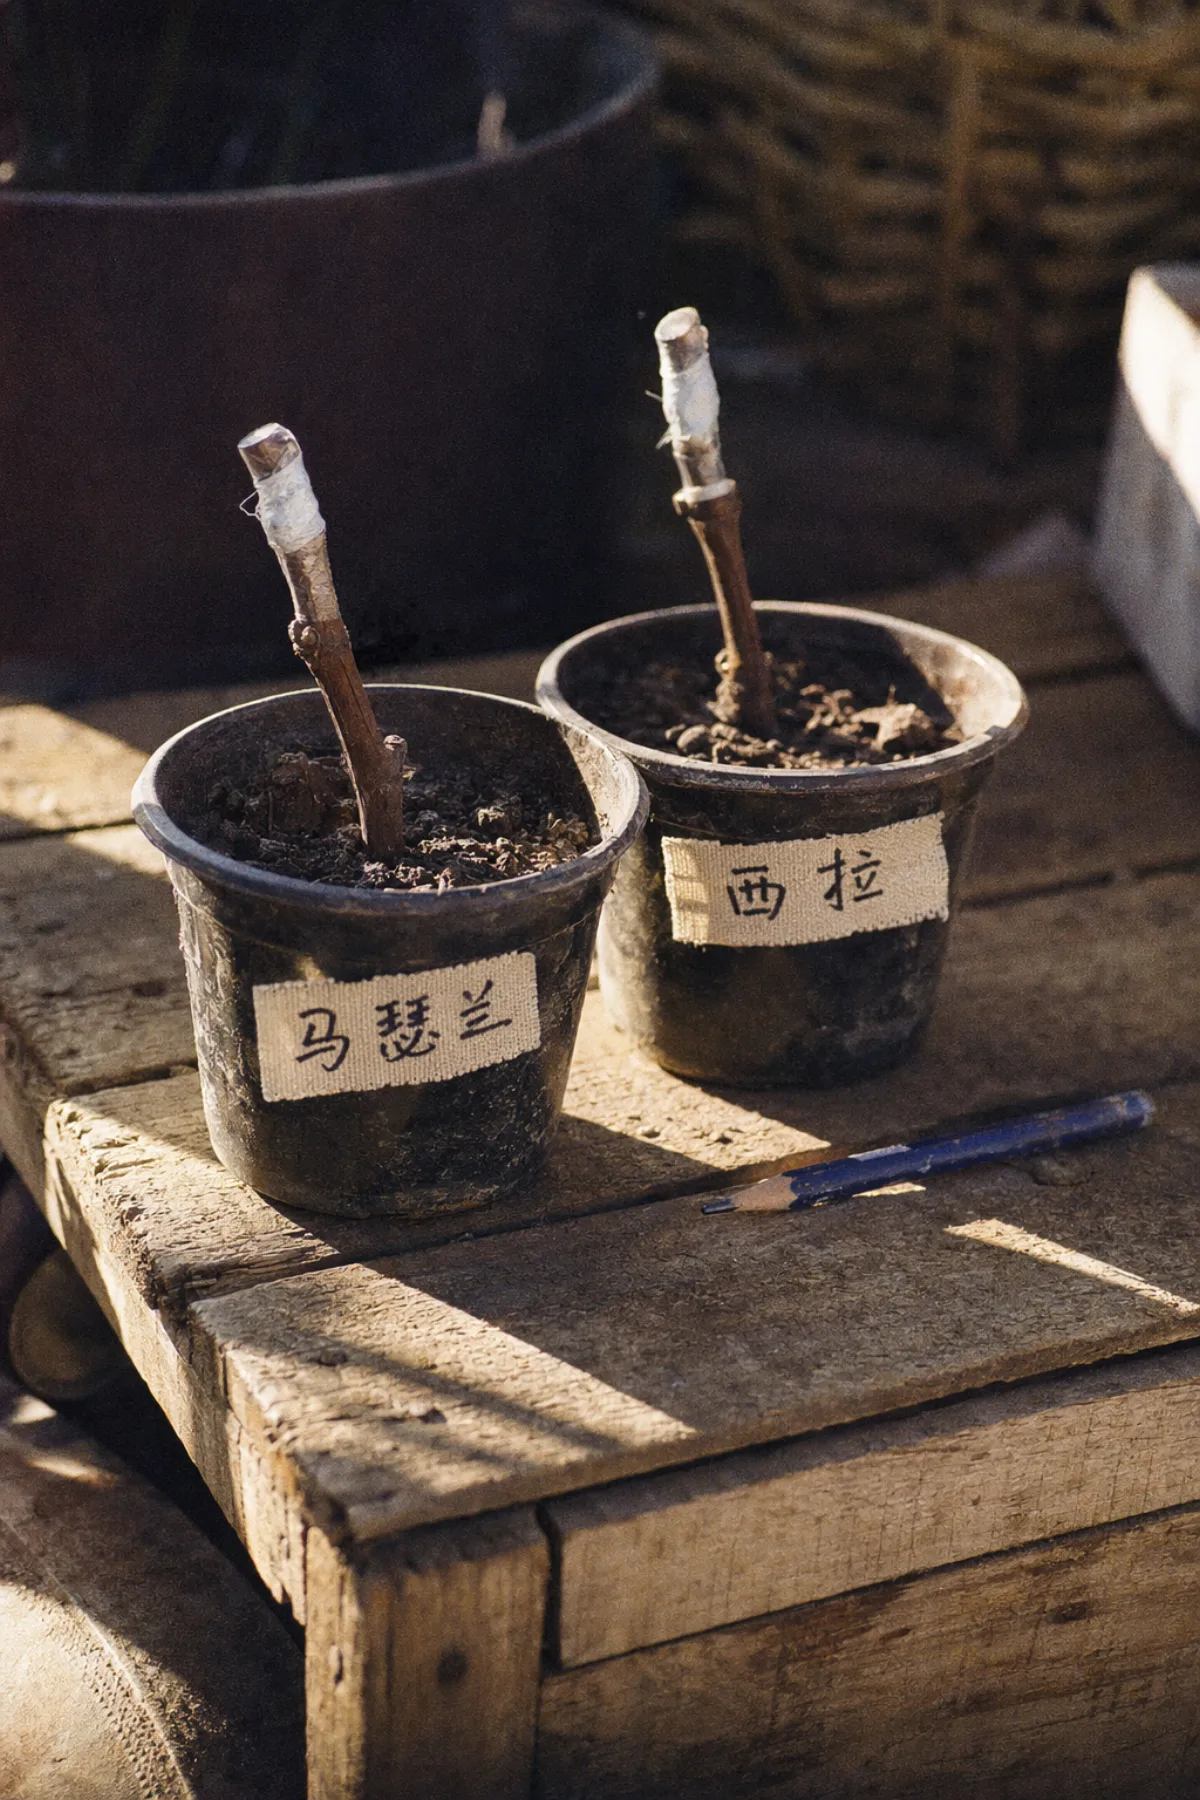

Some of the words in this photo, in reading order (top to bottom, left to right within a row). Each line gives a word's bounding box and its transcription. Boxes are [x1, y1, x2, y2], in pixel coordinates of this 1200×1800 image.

[727, 848, 883, 921] 西拉
[295, 979, 513, 1072] 马瑟兰
